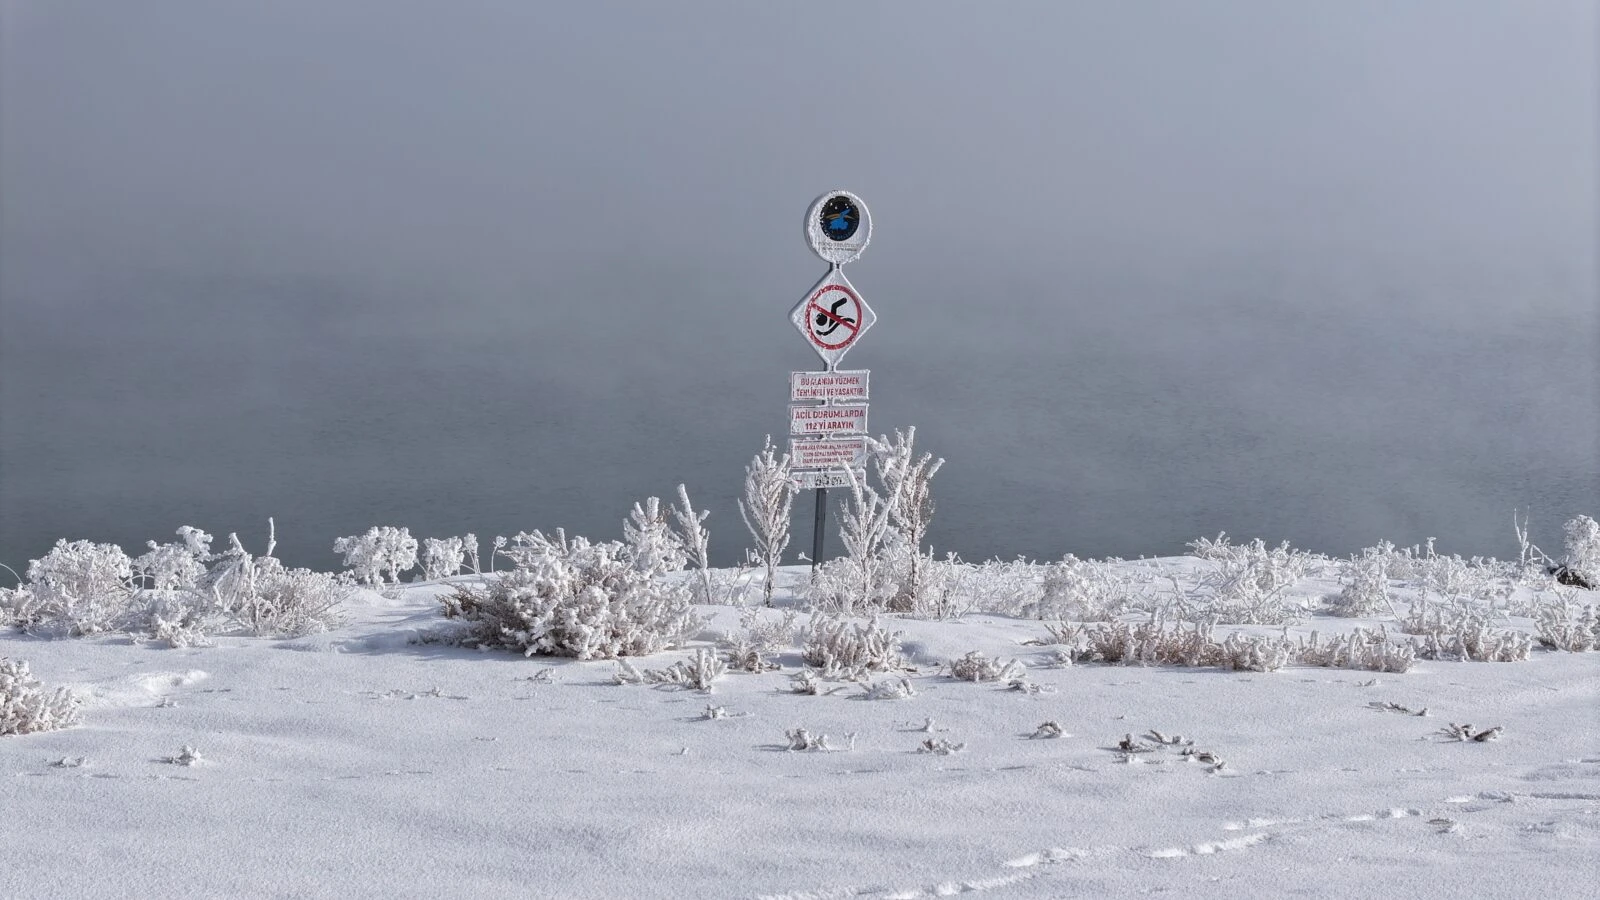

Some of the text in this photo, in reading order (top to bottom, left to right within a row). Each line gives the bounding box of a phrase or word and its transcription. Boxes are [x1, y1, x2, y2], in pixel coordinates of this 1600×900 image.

[800, 378, 810, 386] BU
[835, 376, 860, 384] YÜZMEK
[834, 388, 864, 396] YASAKTIR
[796, 409, 864, 419] ACİL DURUMLARDA
[827, 421, 854, 429] ARAYIN
